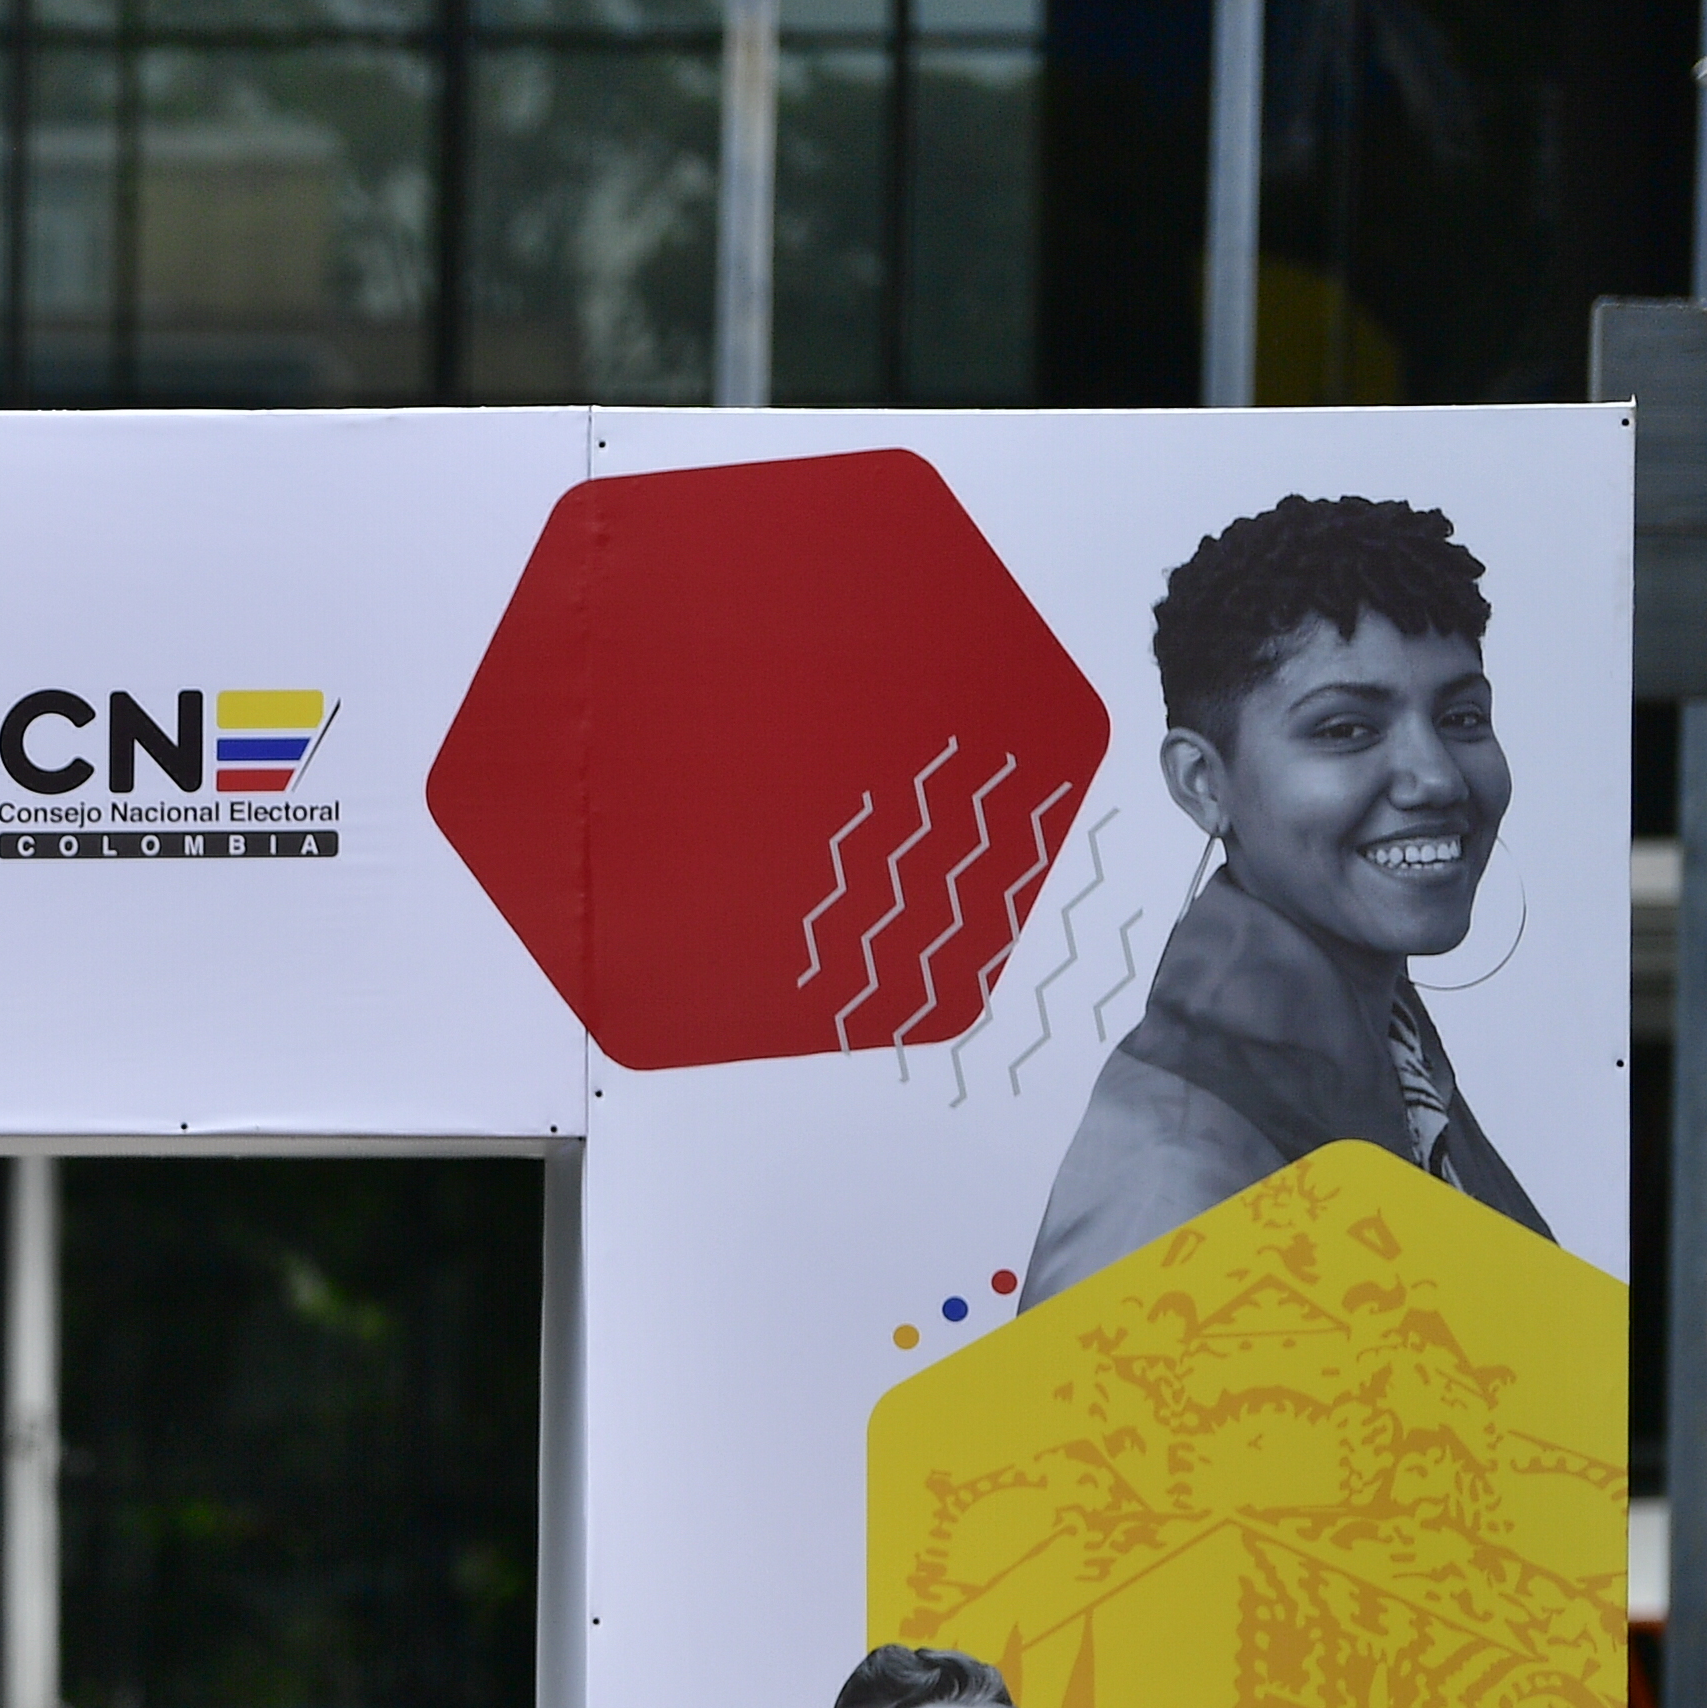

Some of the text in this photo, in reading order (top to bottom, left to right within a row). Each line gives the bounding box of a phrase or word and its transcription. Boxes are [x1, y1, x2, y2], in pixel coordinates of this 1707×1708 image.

[111, 800, 221, 824] Nacional
[229, 800, 341, 824] Electoral
[16, 834, 320, 857] COLOMBIA
